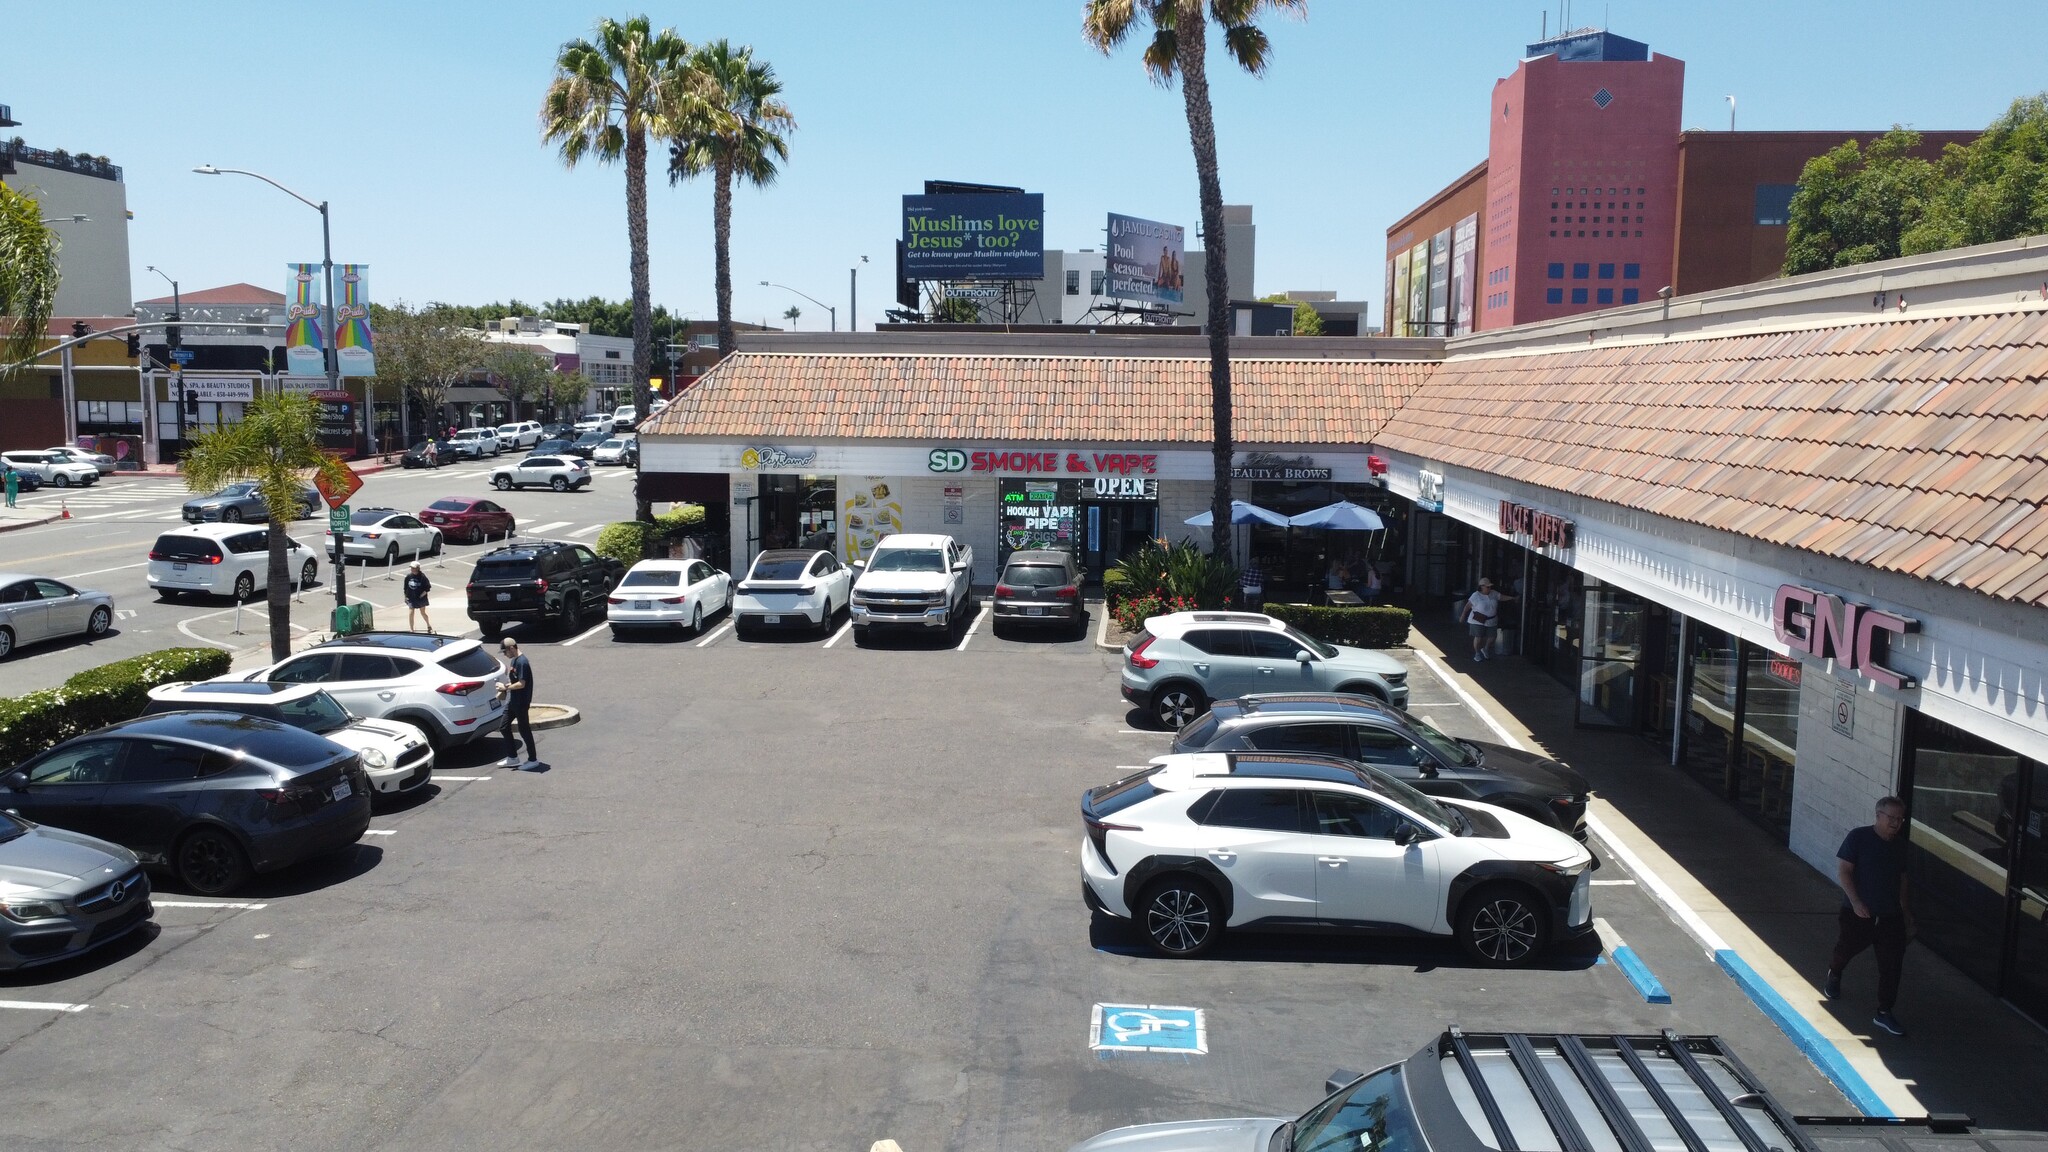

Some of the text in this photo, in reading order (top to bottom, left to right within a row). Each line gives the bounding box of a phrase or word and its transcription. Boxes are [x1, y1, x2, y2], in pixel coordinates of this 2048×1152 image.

[908, 214, 1039, 232] Muslims love
[1121, 219, 1151, 238] JAMUL
[977, 231, 1020, 248] too?
[931, 250, 953, 258] know
[953, 251, 972, 259] your
[973, 250, 1002, 258] Muslim
[1003, 249, 1040, 259] neighbor.
[1114, 243, 1134, 260] Pool
[1112, 278, 1156, 295] perfected.
[288, 304, 317, 320] Pride
[337, 305, 364, 321] Pride
[928, 449, 1158, 475] SD SMOKE & VAPE
[1285, 468, 1328, 478] BROWS
[1094, 477, 1146, 496] OPEN
[1005, 493, 1024, 502] ATM
[1006, 506, 1039, 517] HOOKAH
[1499, 499, 1530, 535] UNCLE
[1025, 517, 1058, 530] PIPE
[1773, 583, 1914, 690] GNC
